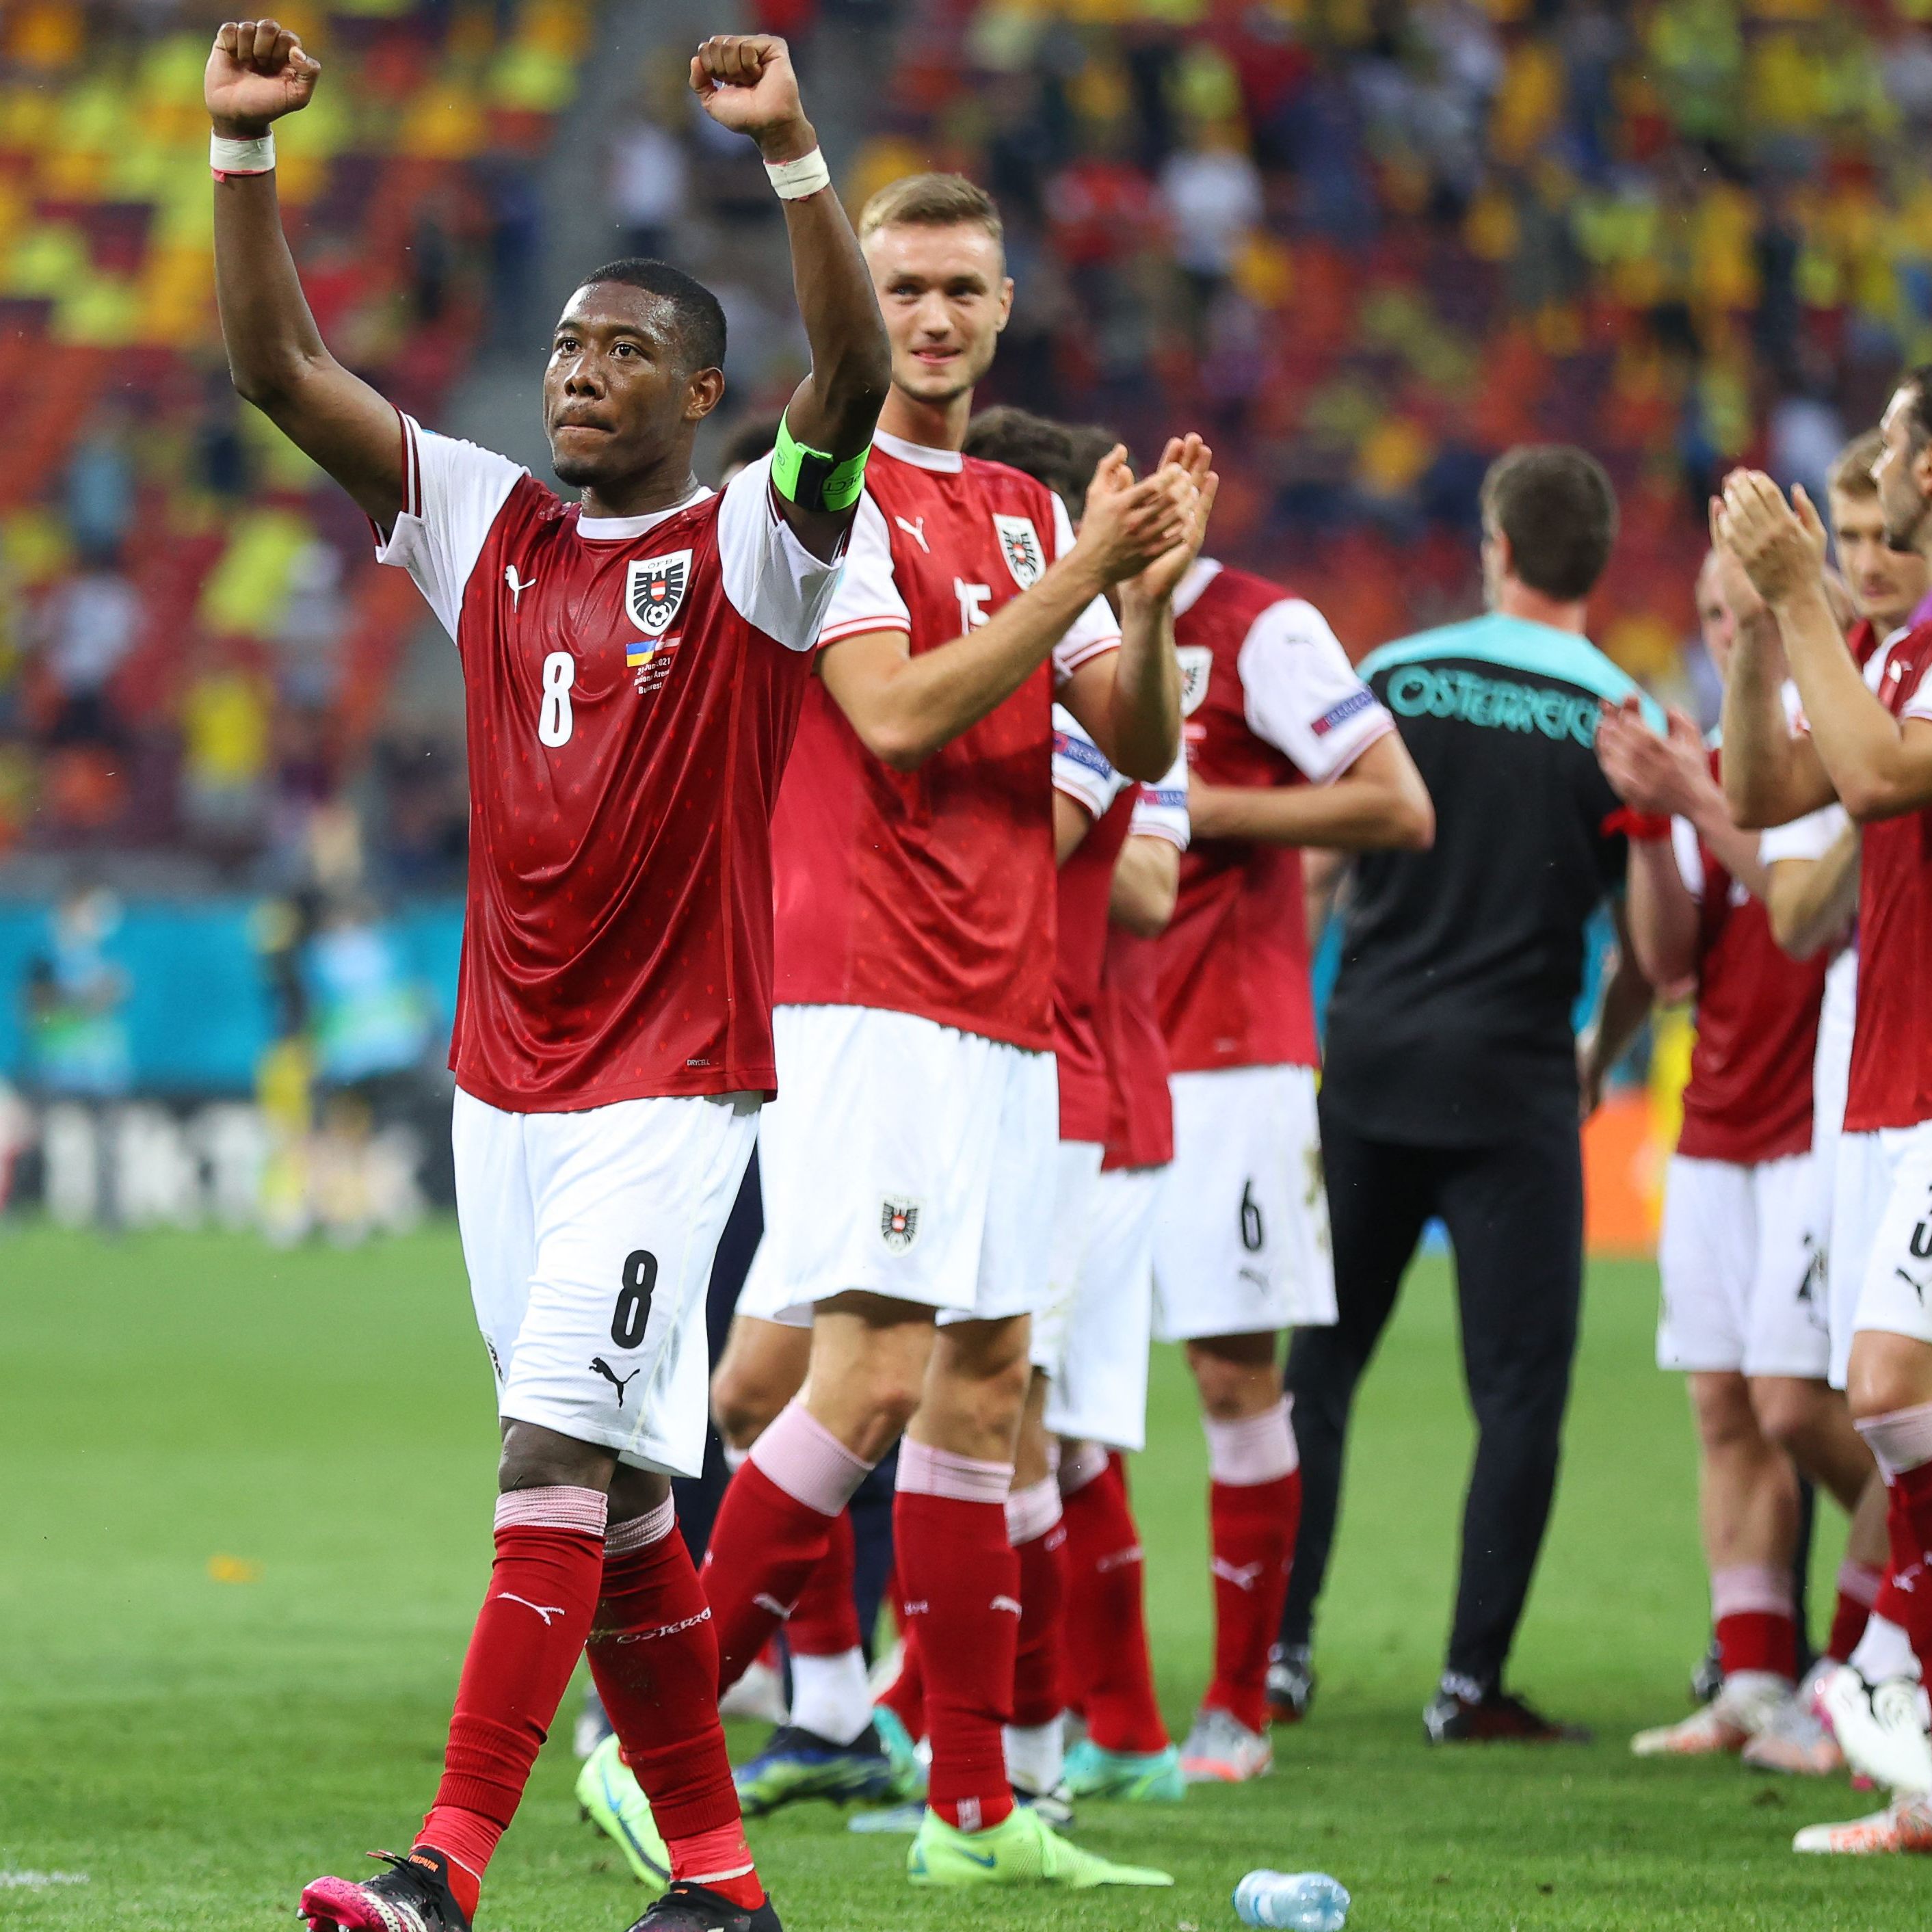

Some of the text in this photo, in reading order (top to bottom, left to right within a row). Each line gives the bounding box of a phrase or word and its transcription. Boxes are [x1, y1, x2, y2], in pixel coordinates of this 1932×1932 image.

[538, 651, 575, 748] 8
[656, 657, 670, 667] 021
[1241, 1178, 1262, 1251] 6
[611, 1249, 658, 1349] 8
